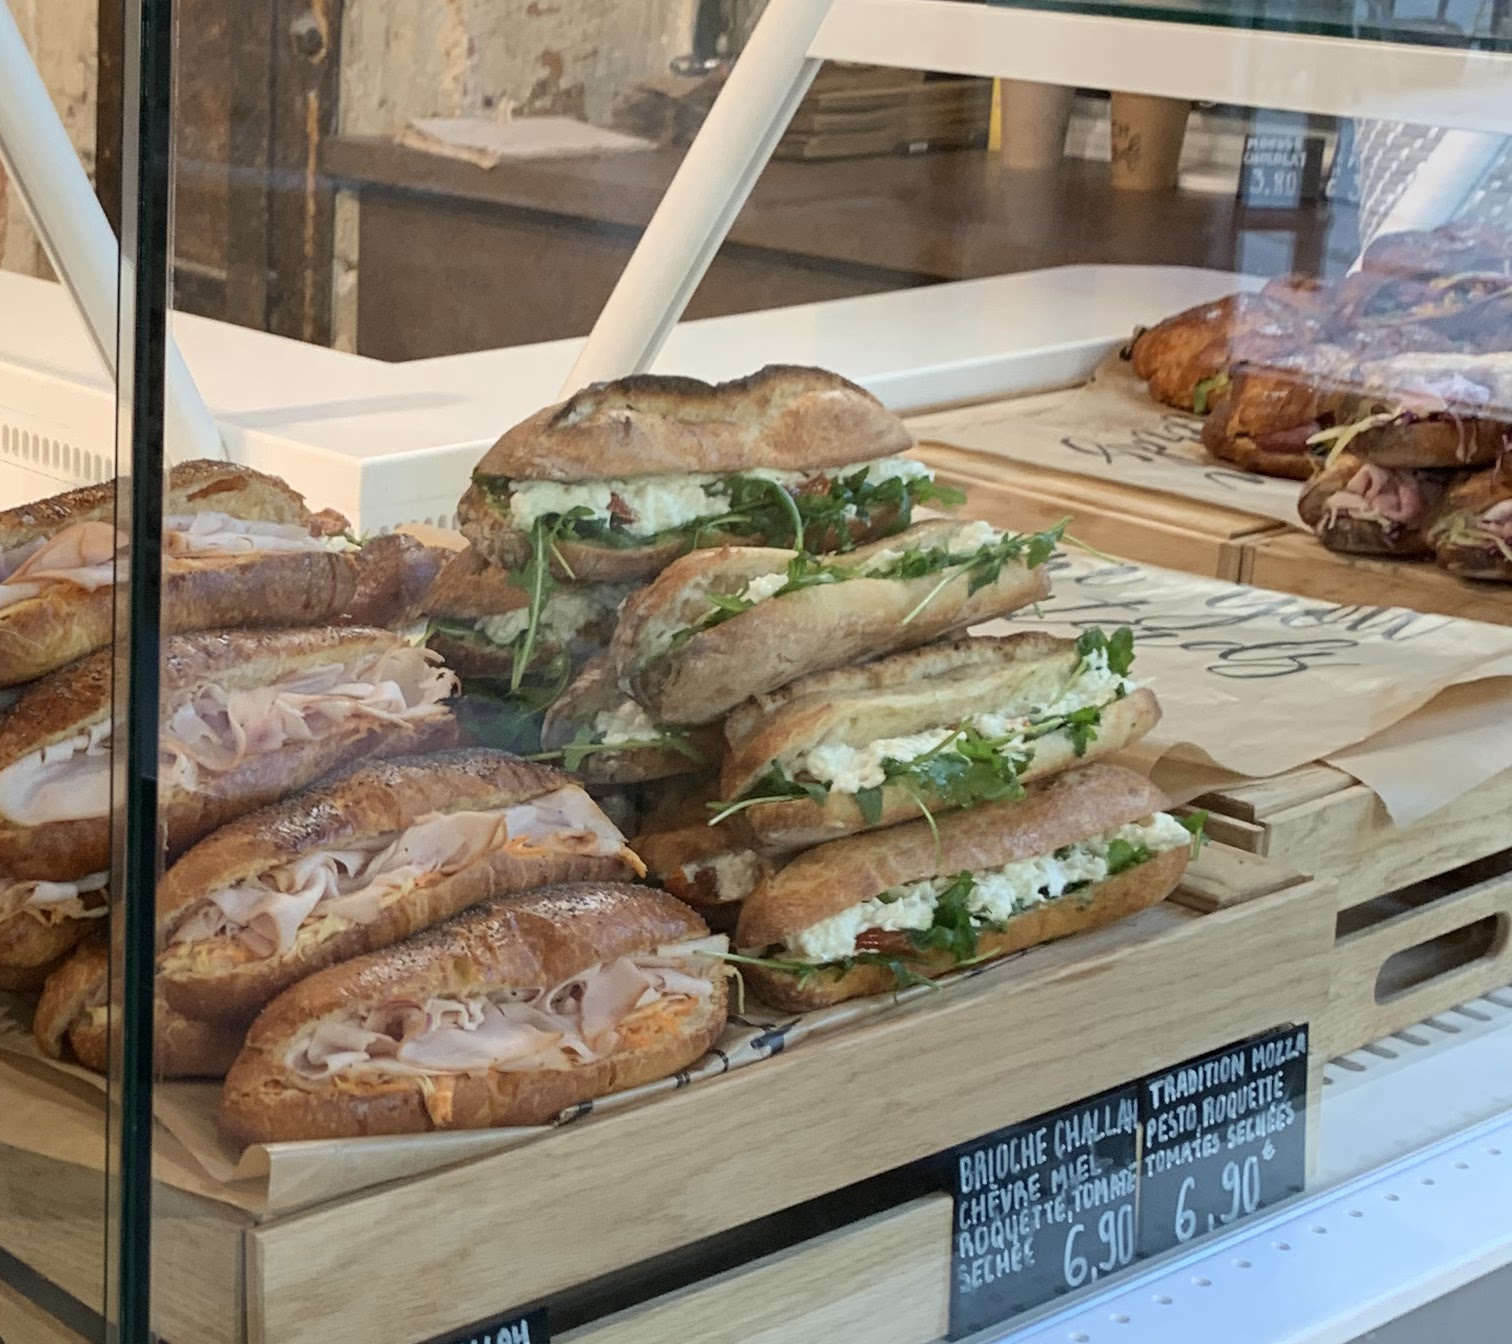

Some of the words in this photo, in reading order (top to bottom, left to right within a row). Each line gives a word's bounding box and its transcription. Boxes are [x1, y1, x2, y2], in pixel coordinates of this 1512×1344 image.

[1148, 1051, 1246, 1110] TRADITION
[1252, 1032, 1306, 1073] MOZZA
[1202, 1070, 1284, 1128] ROQUETTE
[960, 1127, 1048, 1194] BRIOCHE
[1054, 1097, 1139, 1160] CHALLAH
[1051, 1153, 1102, 1194] MIEL
[1145, 1132, 1220, 1177] TOMATES
[1063, 1203, 1135, 1288] 6,90
